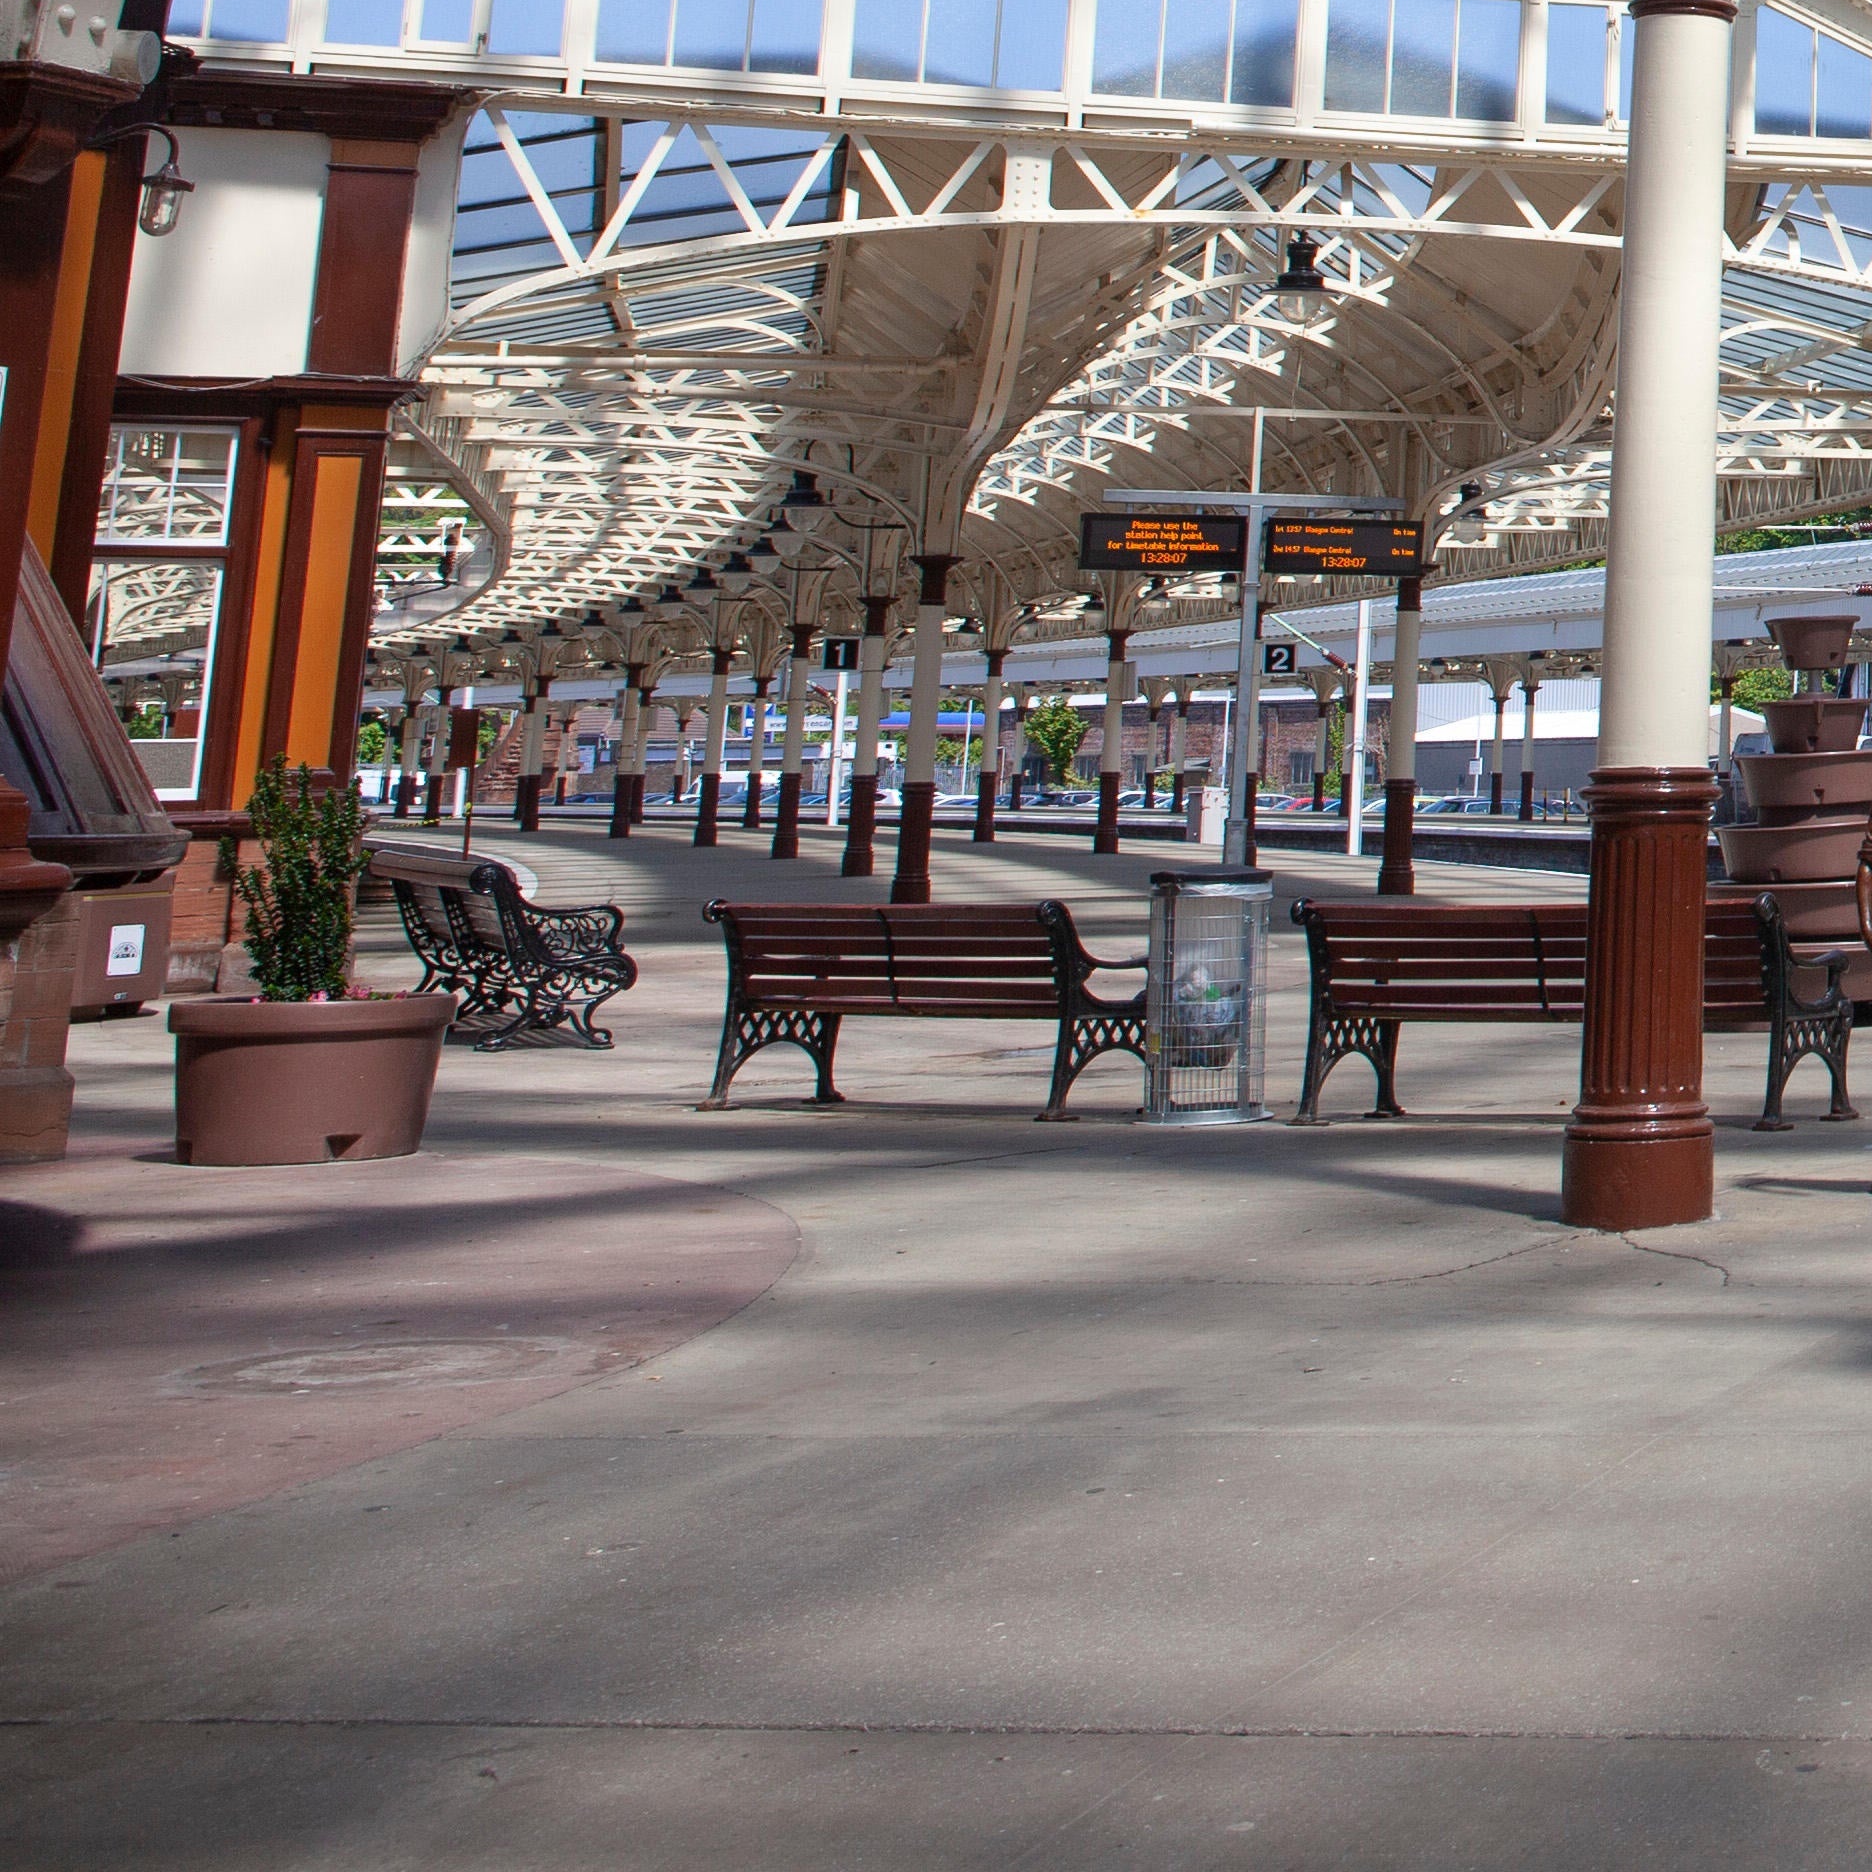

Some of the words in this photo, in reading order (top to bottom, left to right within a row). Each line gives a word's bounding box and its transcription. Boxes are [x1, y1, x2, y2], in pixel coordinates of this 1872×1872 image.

[1131, 520, 1161, 530] Please
[1163, 522, 1180, 530] use
[1183, 521, 1199, 531] the
[1330, 526, 1354, 535] Central
[1125, 531, 1158, 539] station
[1160, 532, 1179, 541] help
[1107, 540, 1122, 549] for
[1125, 541, 1167, 550] timetable
[1168, 542, 1219, 551] information
[1329, 546, 1352, 554] Central
[1140, 552, 1187, 563] 13:28:07
[1321, 557, 1367, 568] 13:28:07
[835, 642, 846, 666] 1
[1271, 647, 1289, 670] 2
